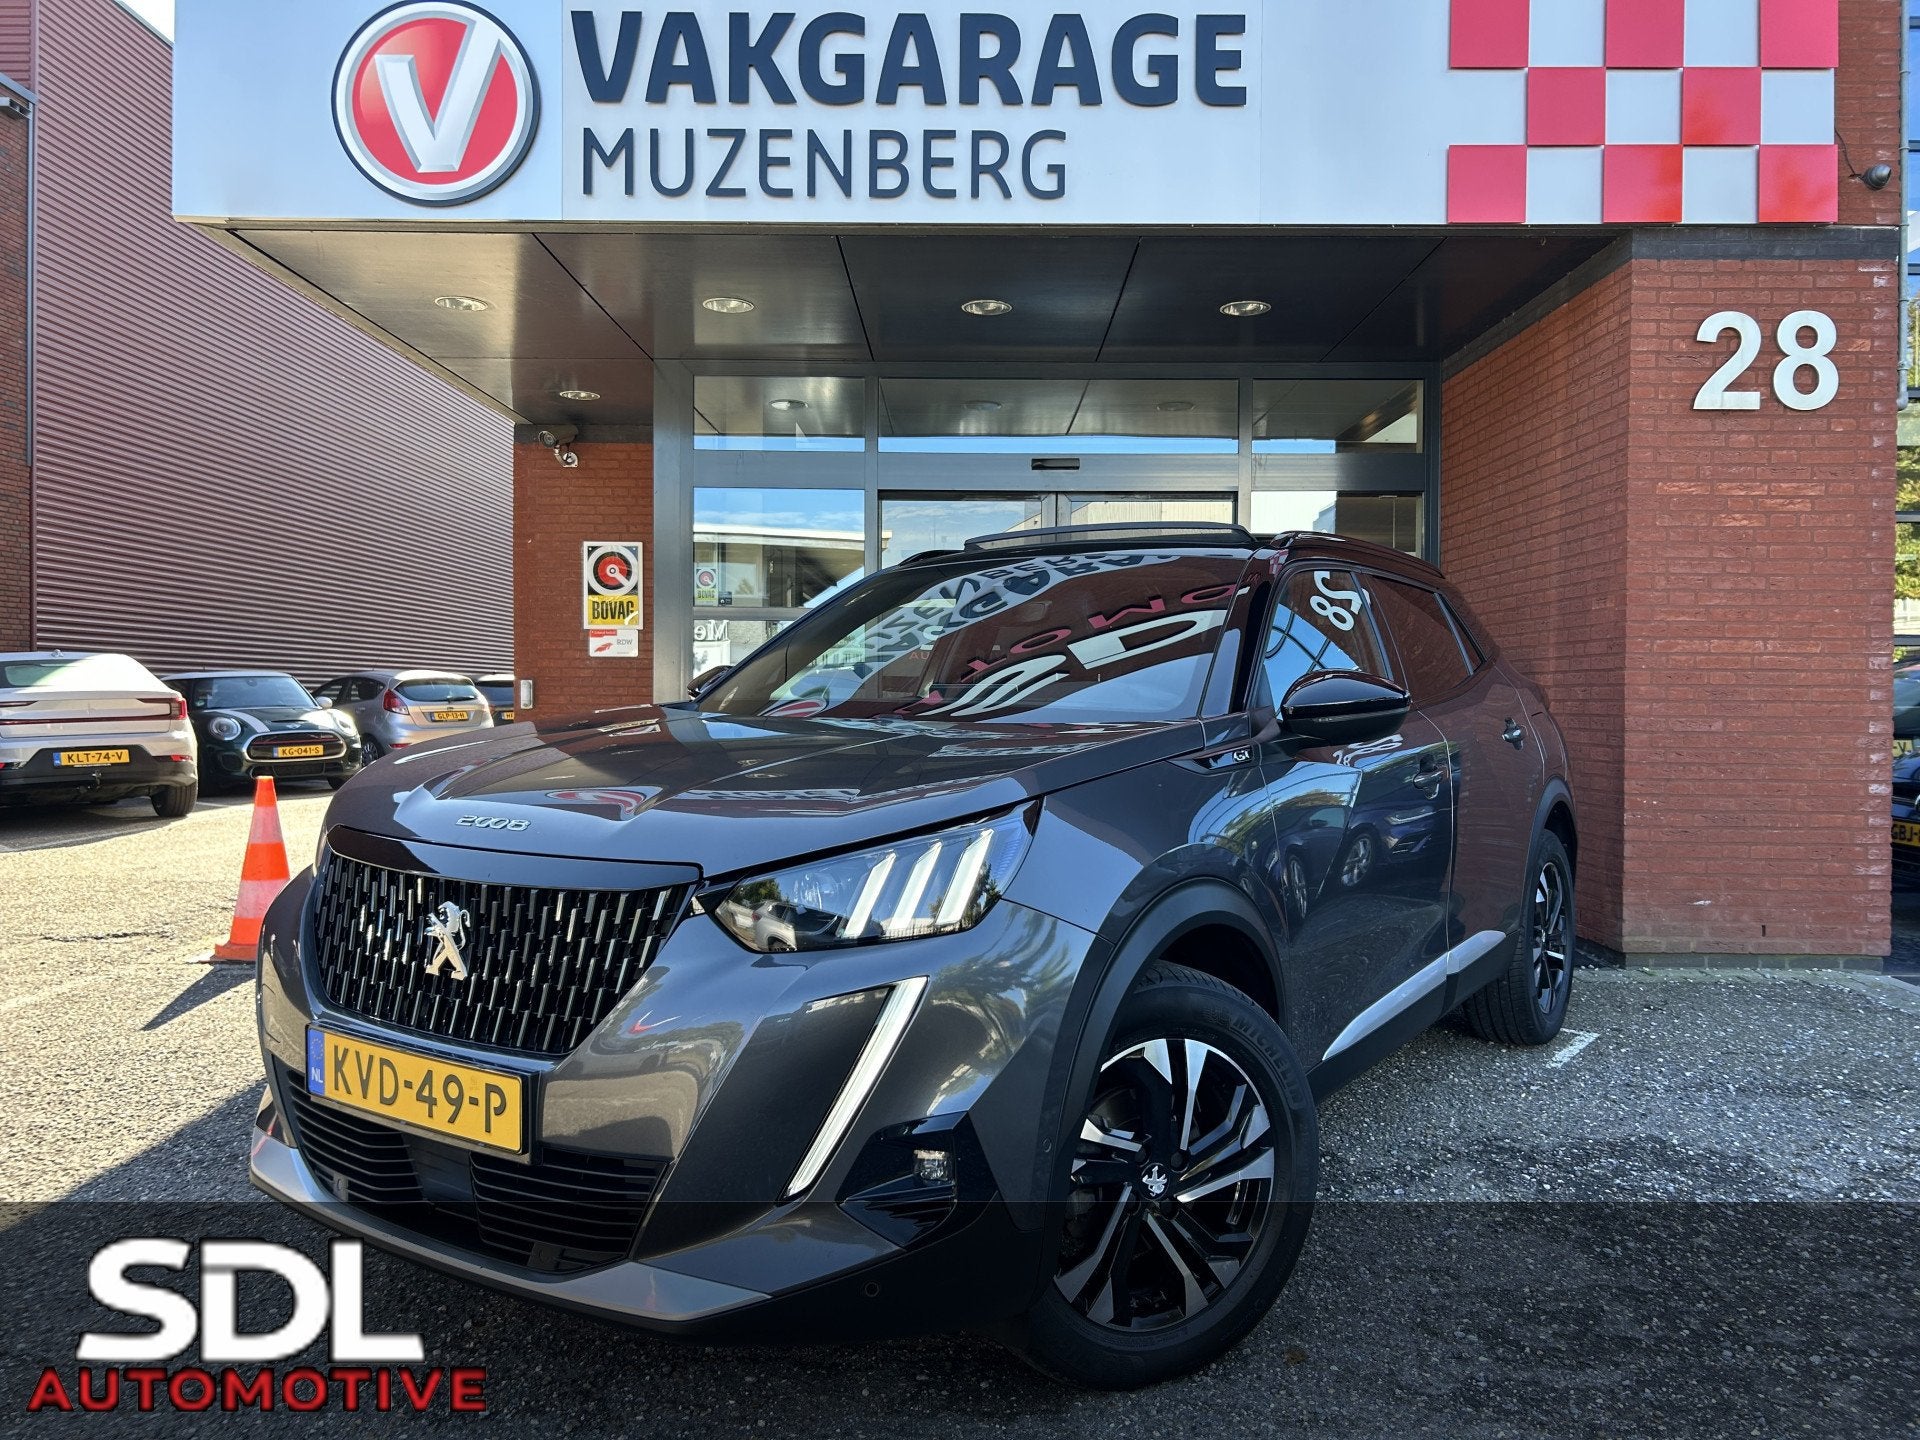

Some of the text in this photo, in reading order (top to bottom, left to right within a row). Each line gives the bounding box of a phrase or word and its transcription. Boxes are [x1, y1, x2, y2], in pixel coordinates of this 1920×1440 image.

[570, 9, 1248, 106] VAKGARAGE
[580, 126, 1069, 200] MUZENBERG
[1693, 310, 1839, 411] 28
[616, 638, 633, 646] RDW
[67, 752, 123, 763] KLT-74-V
[282, 747, 319, 756] KG-041-S
[456, 815, 530, 833] 2008
[311, 1066, 324, 1084] NL
[334, 1045, 507, 1133] KVD-49-P
